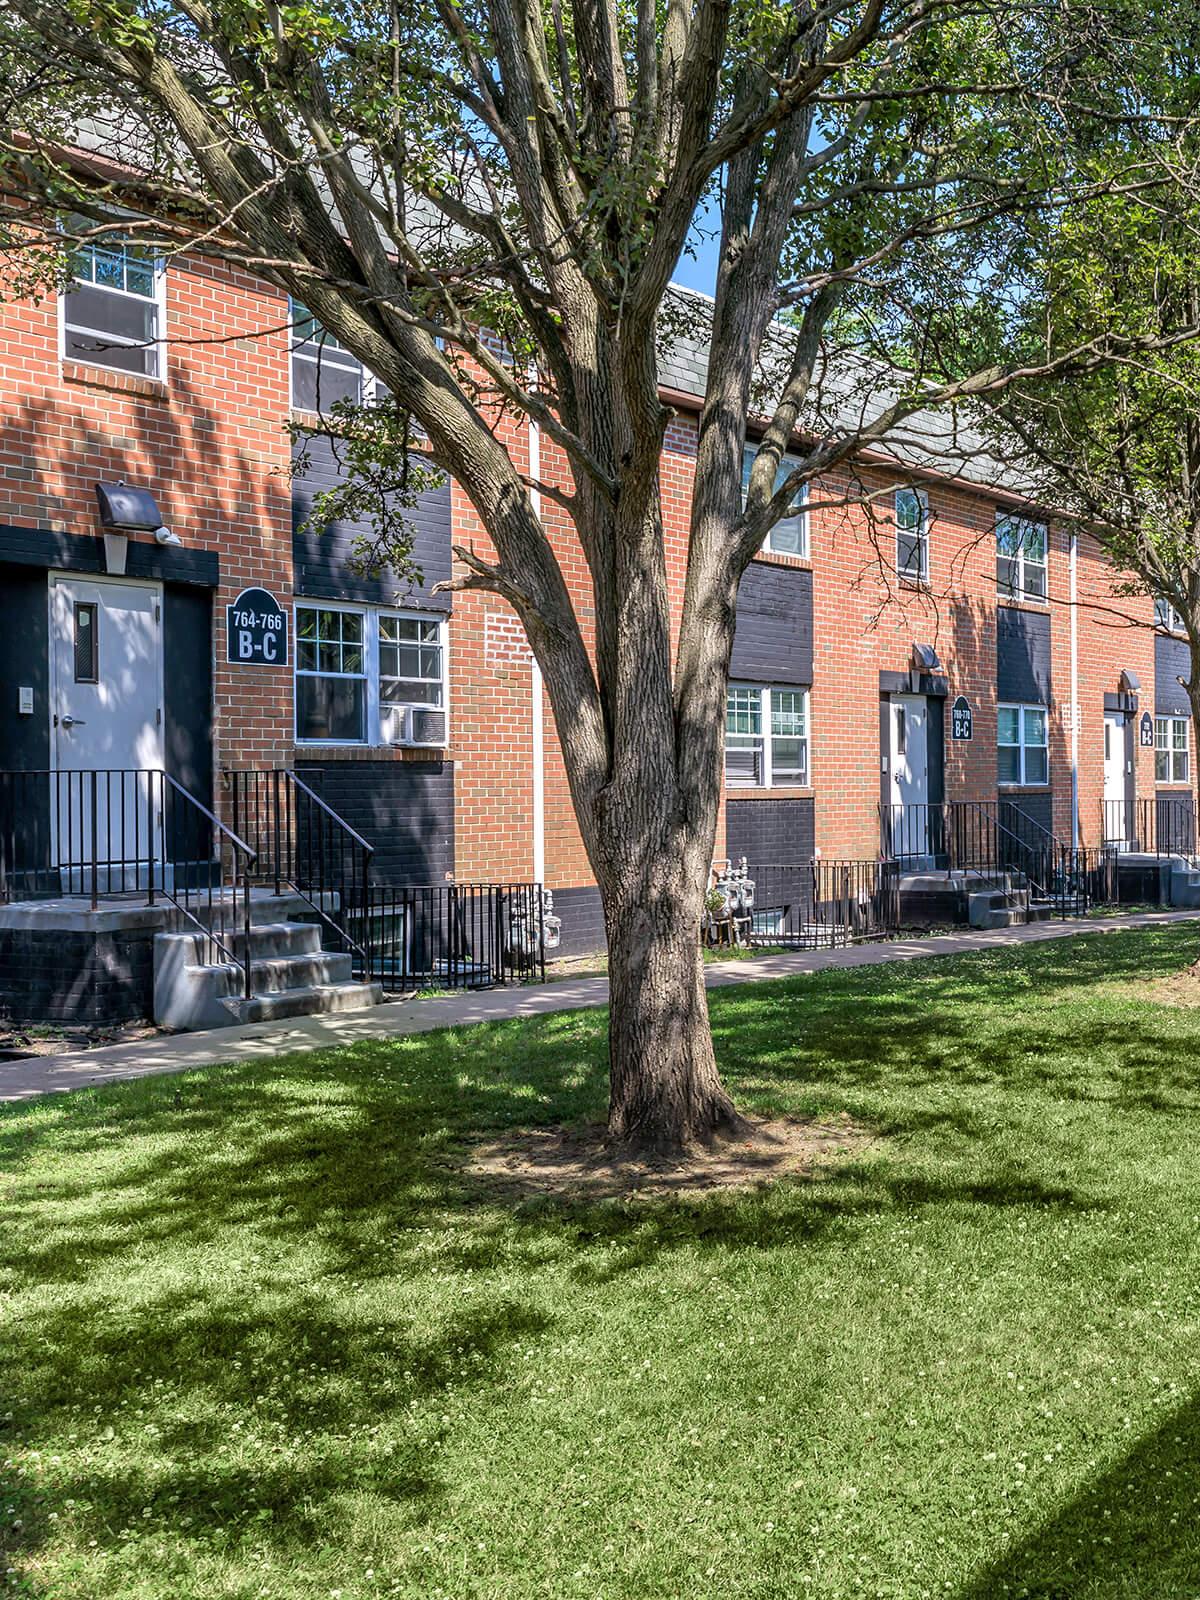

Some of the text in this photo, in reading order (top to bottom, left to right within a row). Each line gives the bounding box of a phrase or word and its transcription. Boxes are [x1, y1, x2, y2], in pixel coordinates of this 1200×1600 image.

[233, 610, 282, 630] 764-766
[239, 630, 277, 660] B-C
[955, 720, 969, 737] B-C
[1142, 730, 1152, 745] B-C
